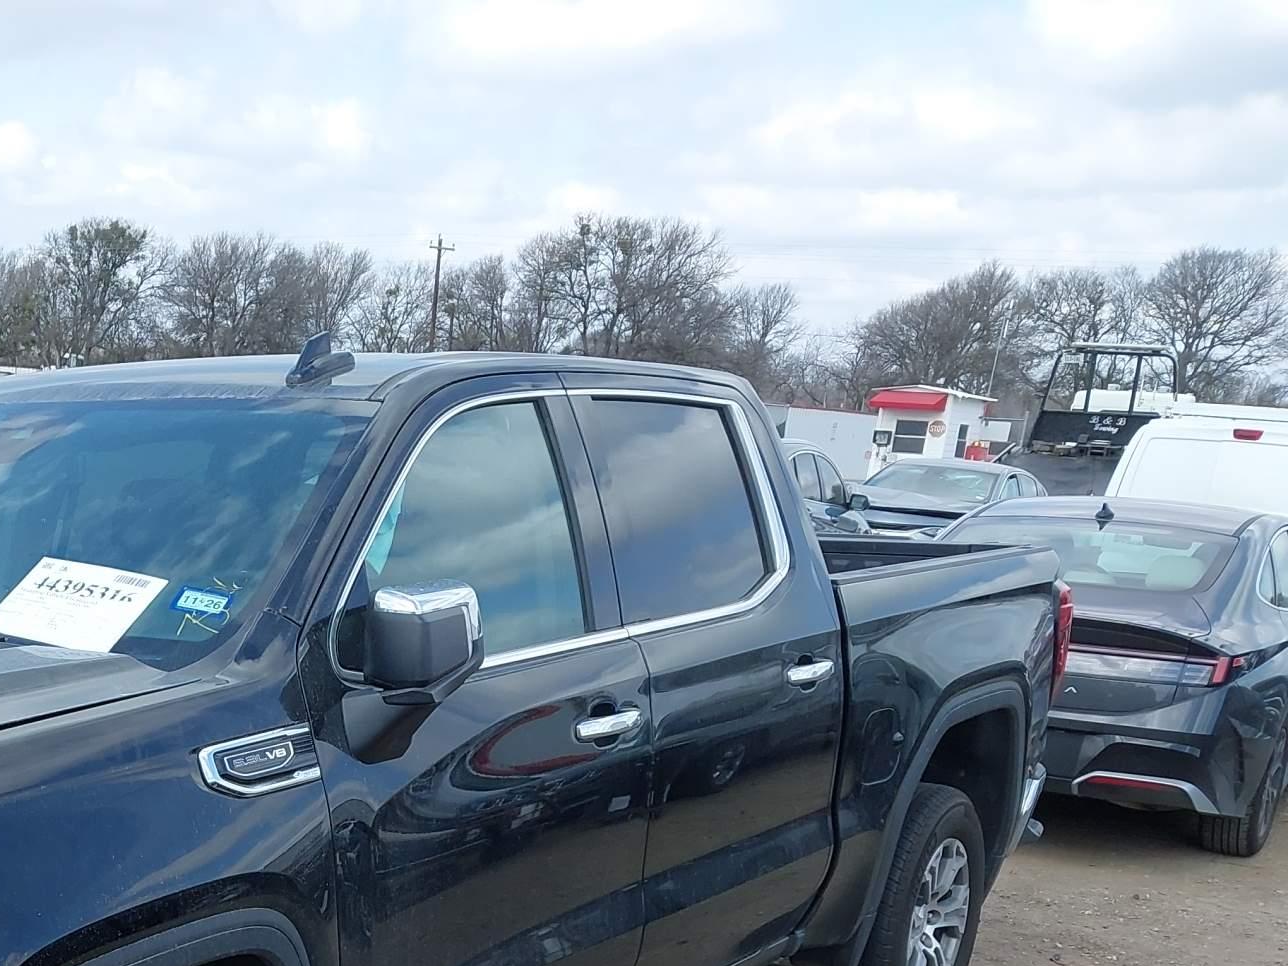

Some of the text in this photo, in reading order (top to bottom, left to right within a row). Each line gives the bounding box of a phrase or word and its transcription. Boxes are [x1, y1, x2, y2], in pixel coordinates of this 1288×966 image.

[1102, 415, 1114, 425] &
[929, 424, 946, 433] STOP
[33, 576, 137, 603] 44395316
[183, 595, 224, 610] 11 26
